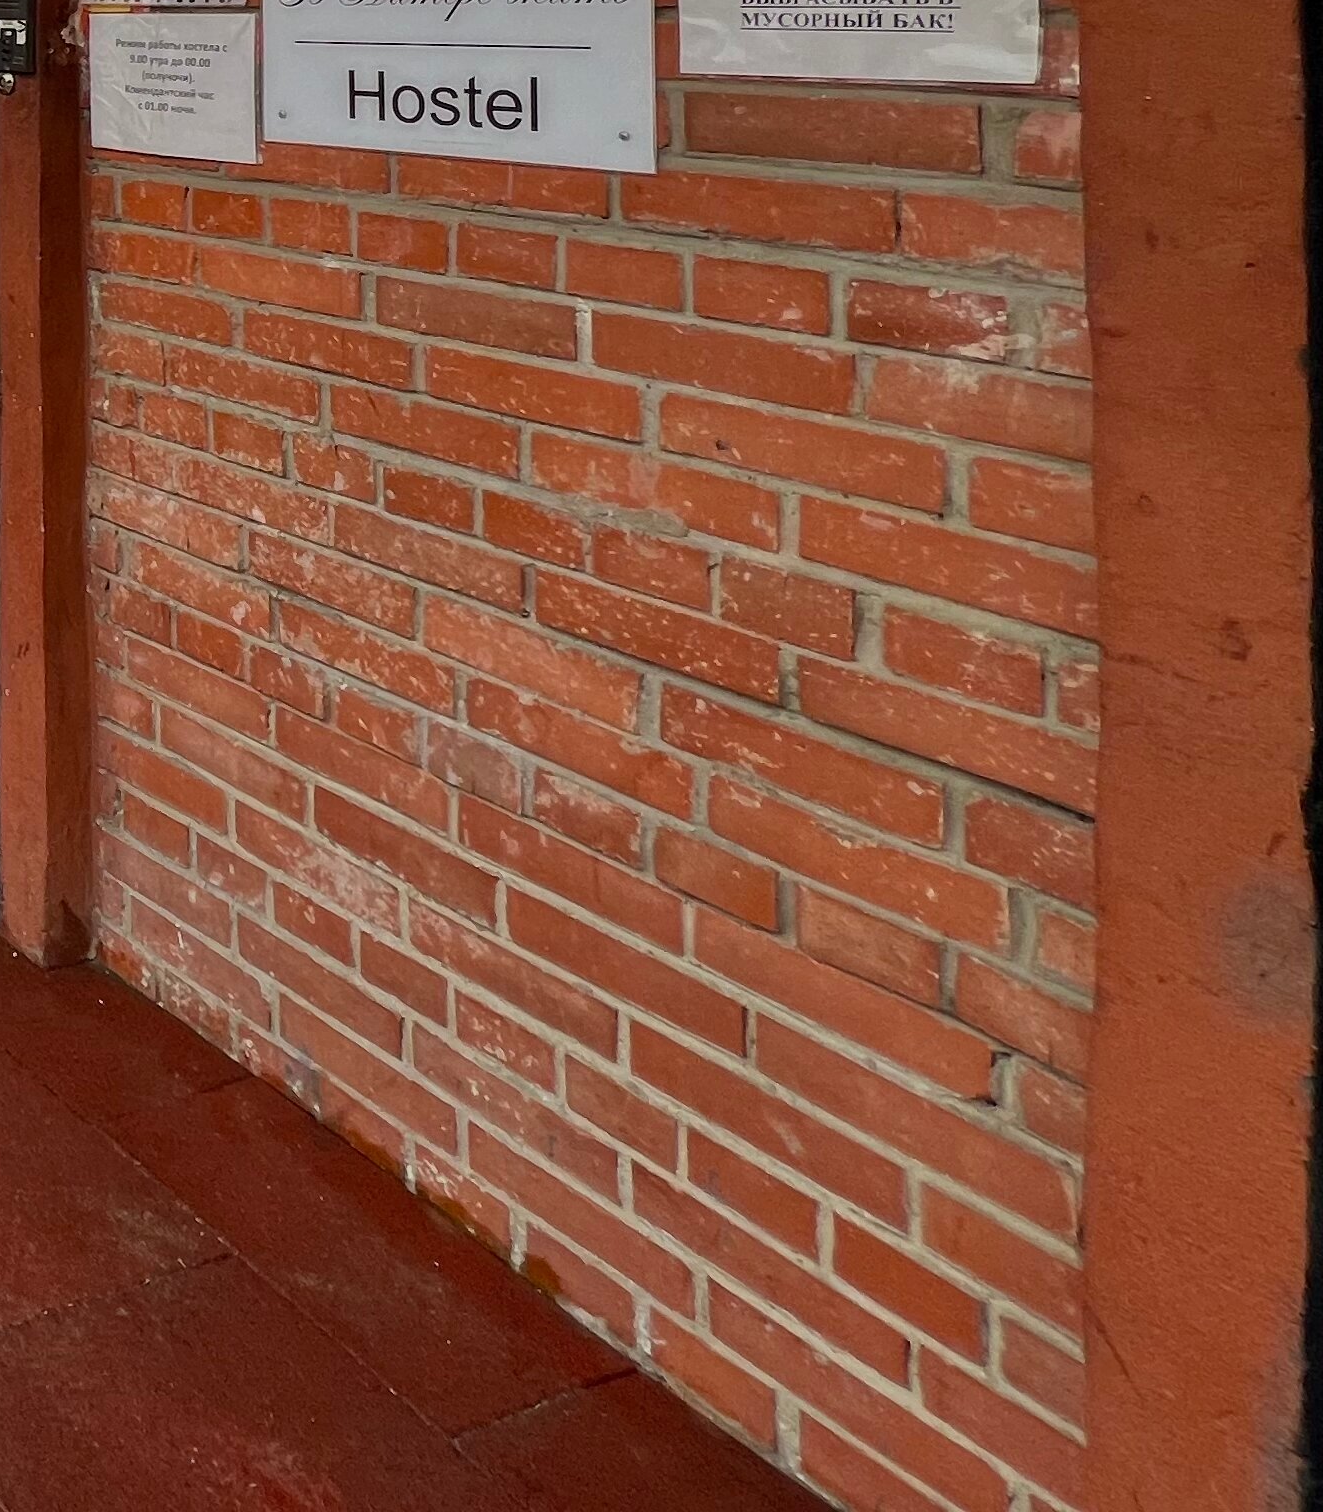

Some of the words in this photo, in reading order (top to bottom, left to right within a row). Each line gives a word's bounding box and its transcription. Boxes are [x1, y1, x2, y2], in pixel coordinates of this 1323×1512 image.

[740, 9, 884, 29] МУСОРНЫЙ
[893, 12, 955, 30] БАК!
[347, 69, 539, 133] Hostel
